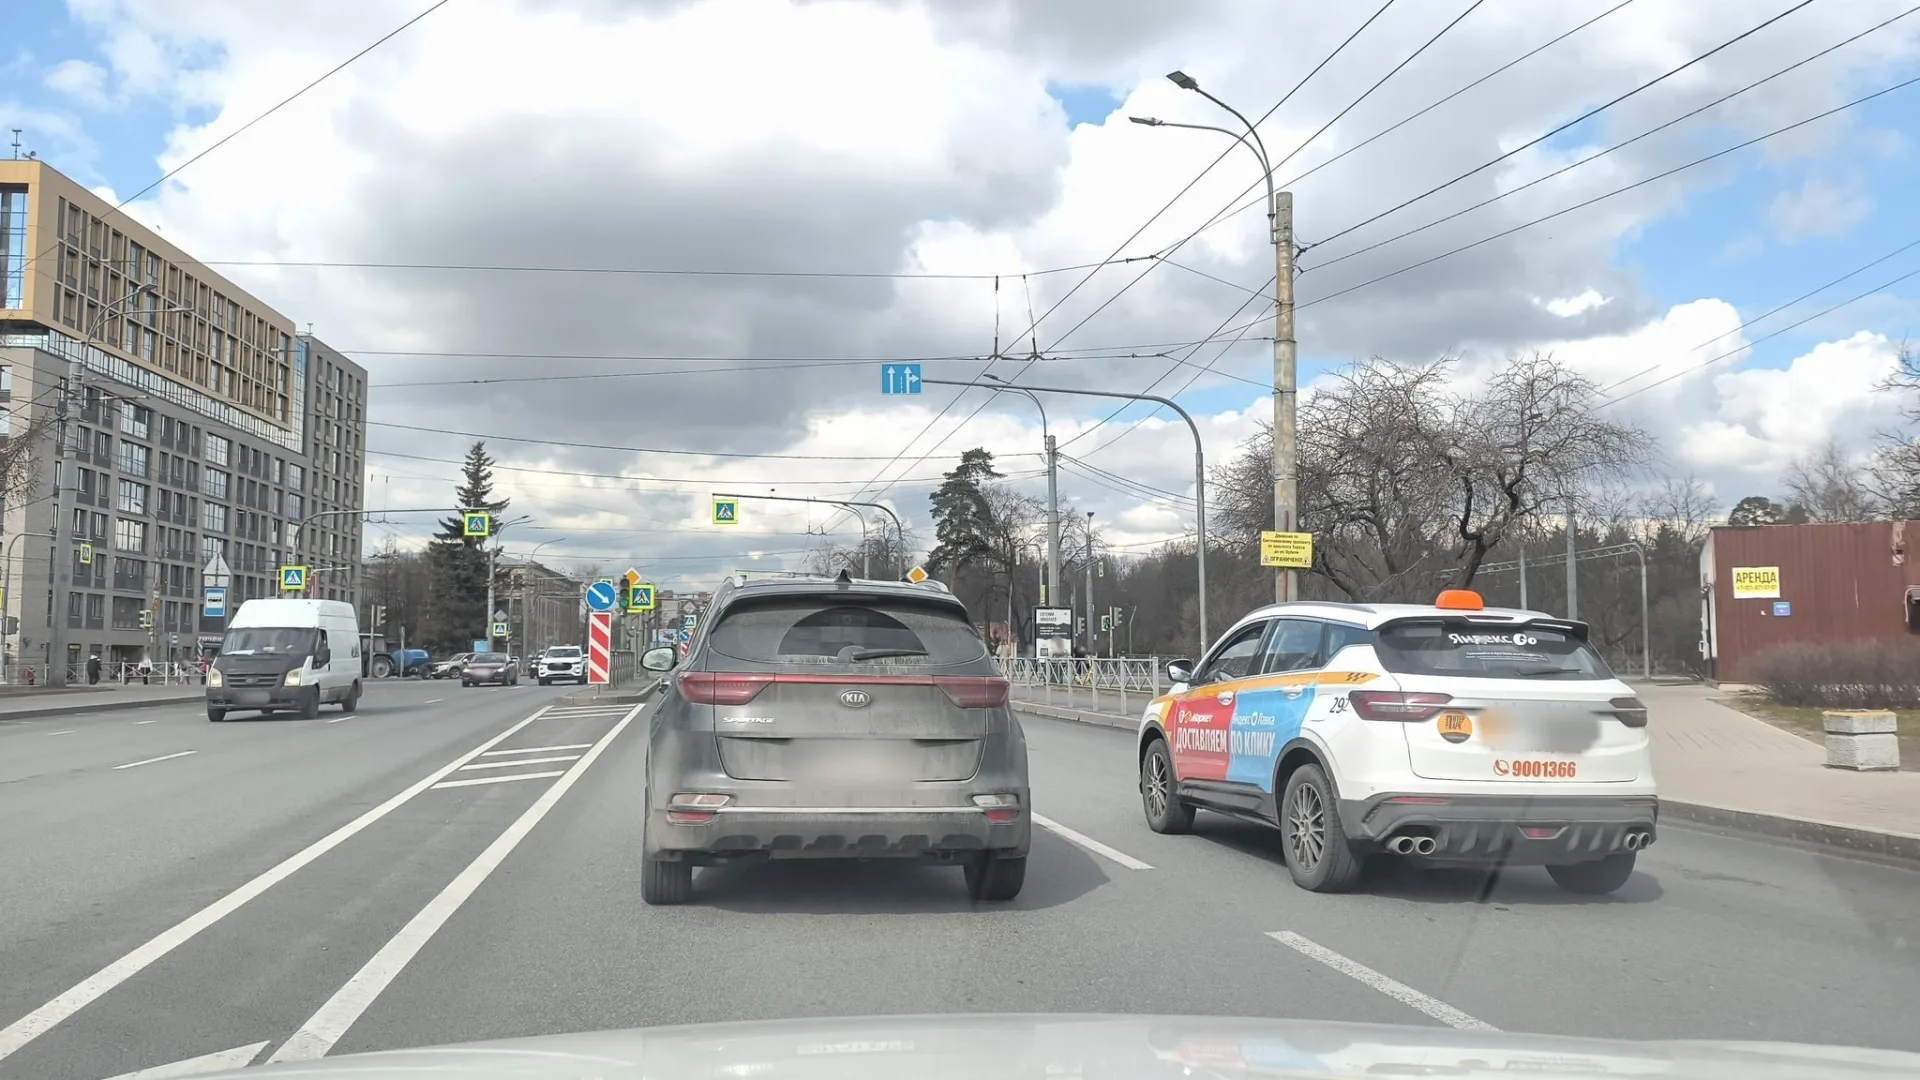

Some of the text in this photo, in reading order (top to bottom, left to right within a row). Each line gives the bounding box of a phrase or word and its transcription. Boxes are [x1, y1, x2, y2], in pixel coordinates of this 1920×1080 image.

[1736, 571, 1777, 584] АРЕНДА
[1512, 633, 1538, 645] Go
[1176, 727, 1276, 758] ДОСТАВЛЯЕМ ПО КЛИКУ
[1512, 760, 1576, 777] 9001366
